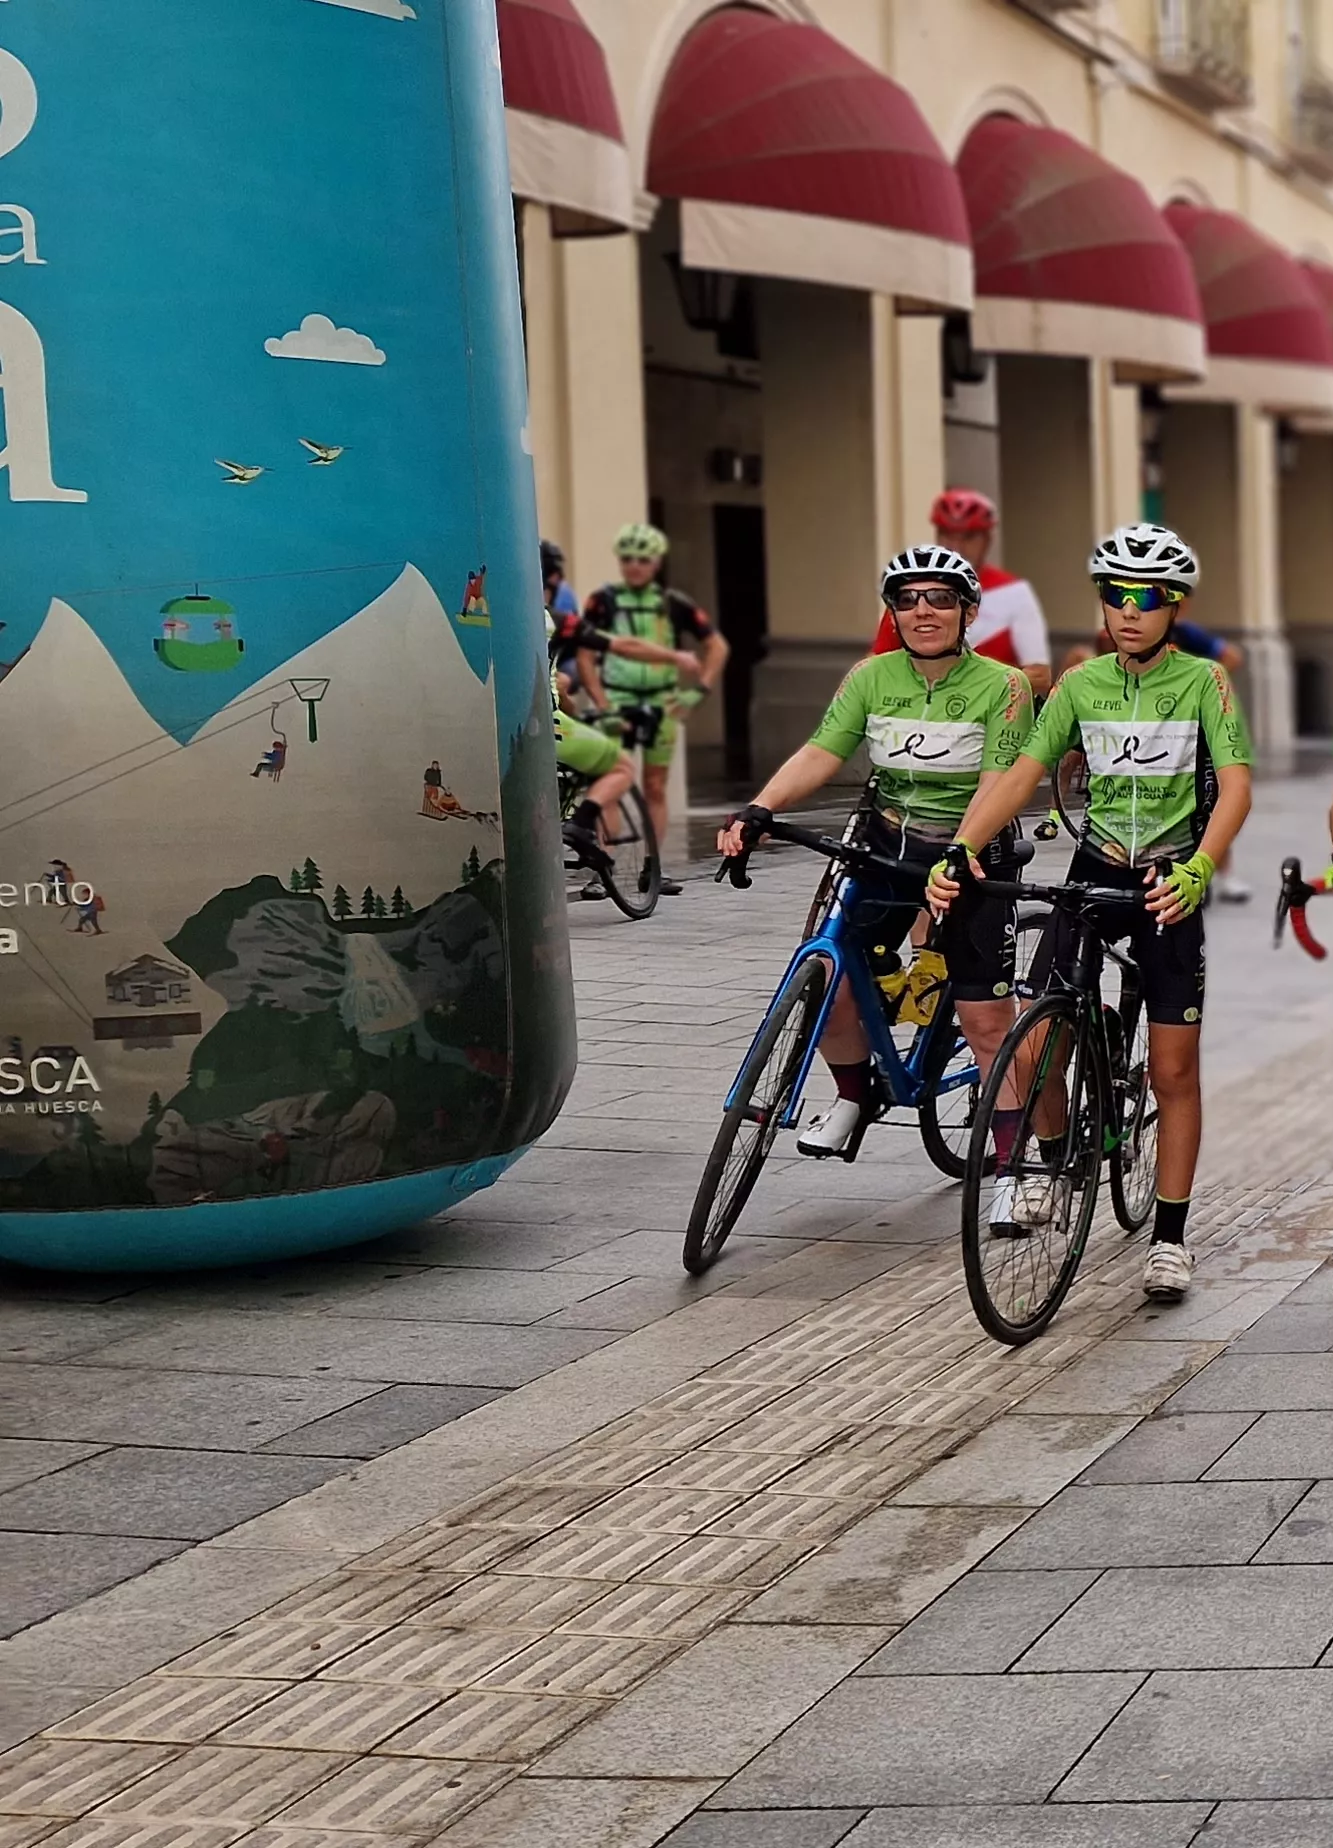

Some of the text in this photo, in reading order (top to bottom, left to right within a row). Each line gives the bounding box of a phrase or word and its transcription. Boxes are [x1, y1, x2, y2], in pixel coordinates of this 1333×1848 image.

[0, 876, 94, 906] ento
[0, 1056, 102, 1095] SCA
[25, 1100, 103, 1114] HUESCA
